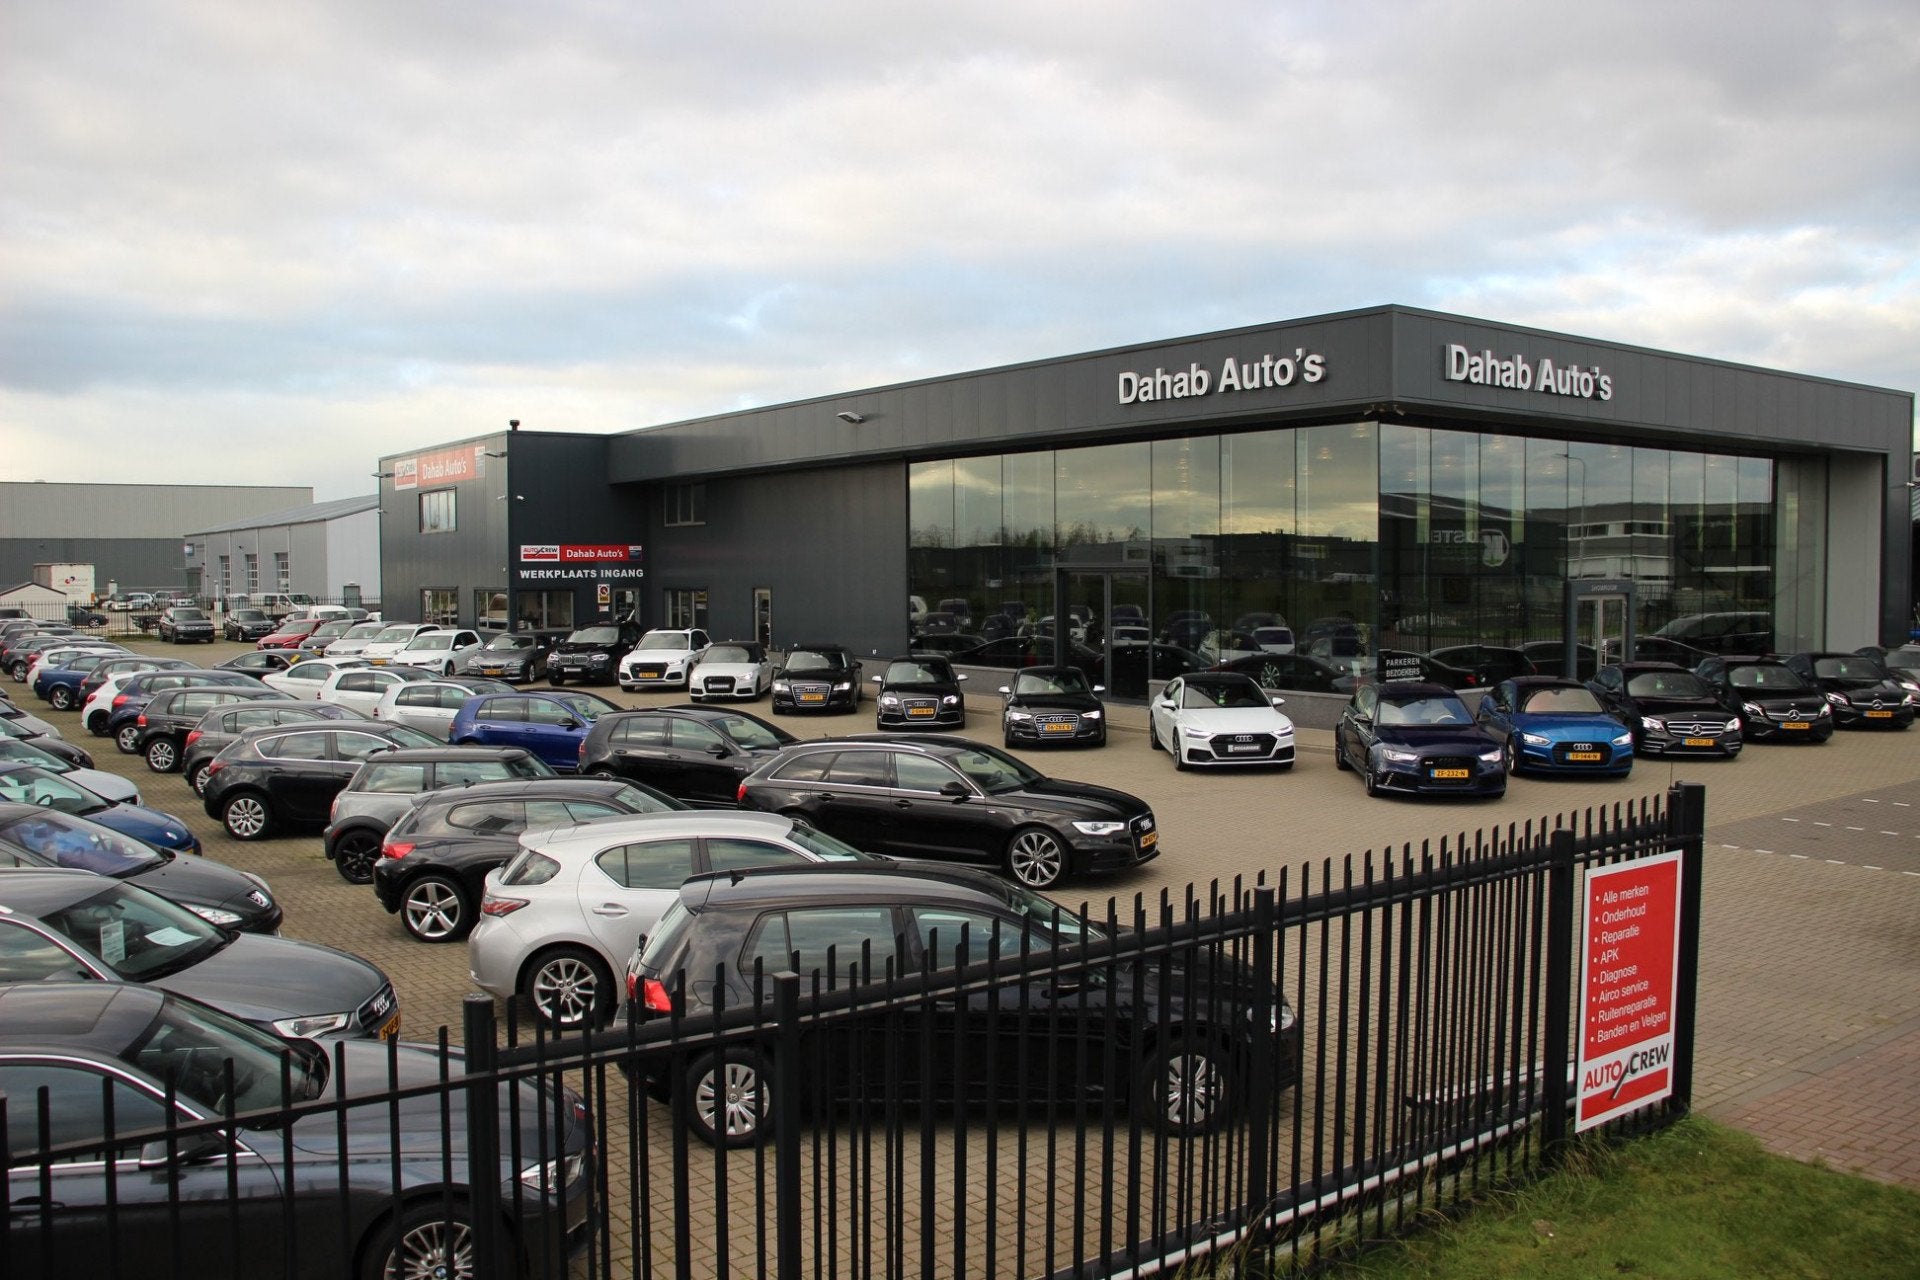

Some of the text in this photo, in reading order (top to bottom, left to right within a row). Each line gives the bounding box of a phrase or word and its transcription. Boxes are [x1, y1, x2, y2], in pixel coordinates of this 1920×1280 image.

[1118, 347, 1326, 404] Dahab Auto's
[1446, 344, 1612, 401] Dahab Auto's
[423, 457, 467, 480] Dahab Auto's
[566, 549, 623, 558] Dahab Auto's
[520, 569, 644, 578] WERKPLAATS INGANG
[1386, 658, 1420, 667] PARKEREN
[1386, 668, 1420, 678] BEZOEKERS
[1602, 885, 1649, 905] Alle merken
[1601, 902, 1646, 924] Onderhoud
[1601, 924, 1640, 945] Reparatie
[1600, 947, 1619, 965] APK
[1600, 964, 1637, 984] Diagnose
[1598, 979, 1649, 1004] Airco service
[1598, 994, 1657, 1023] Ruitenreparatie
[1597, 1011, 1667, 1043] Banden en Velgen
[1583, 1043, 1670, 1092] AUTO CREW
